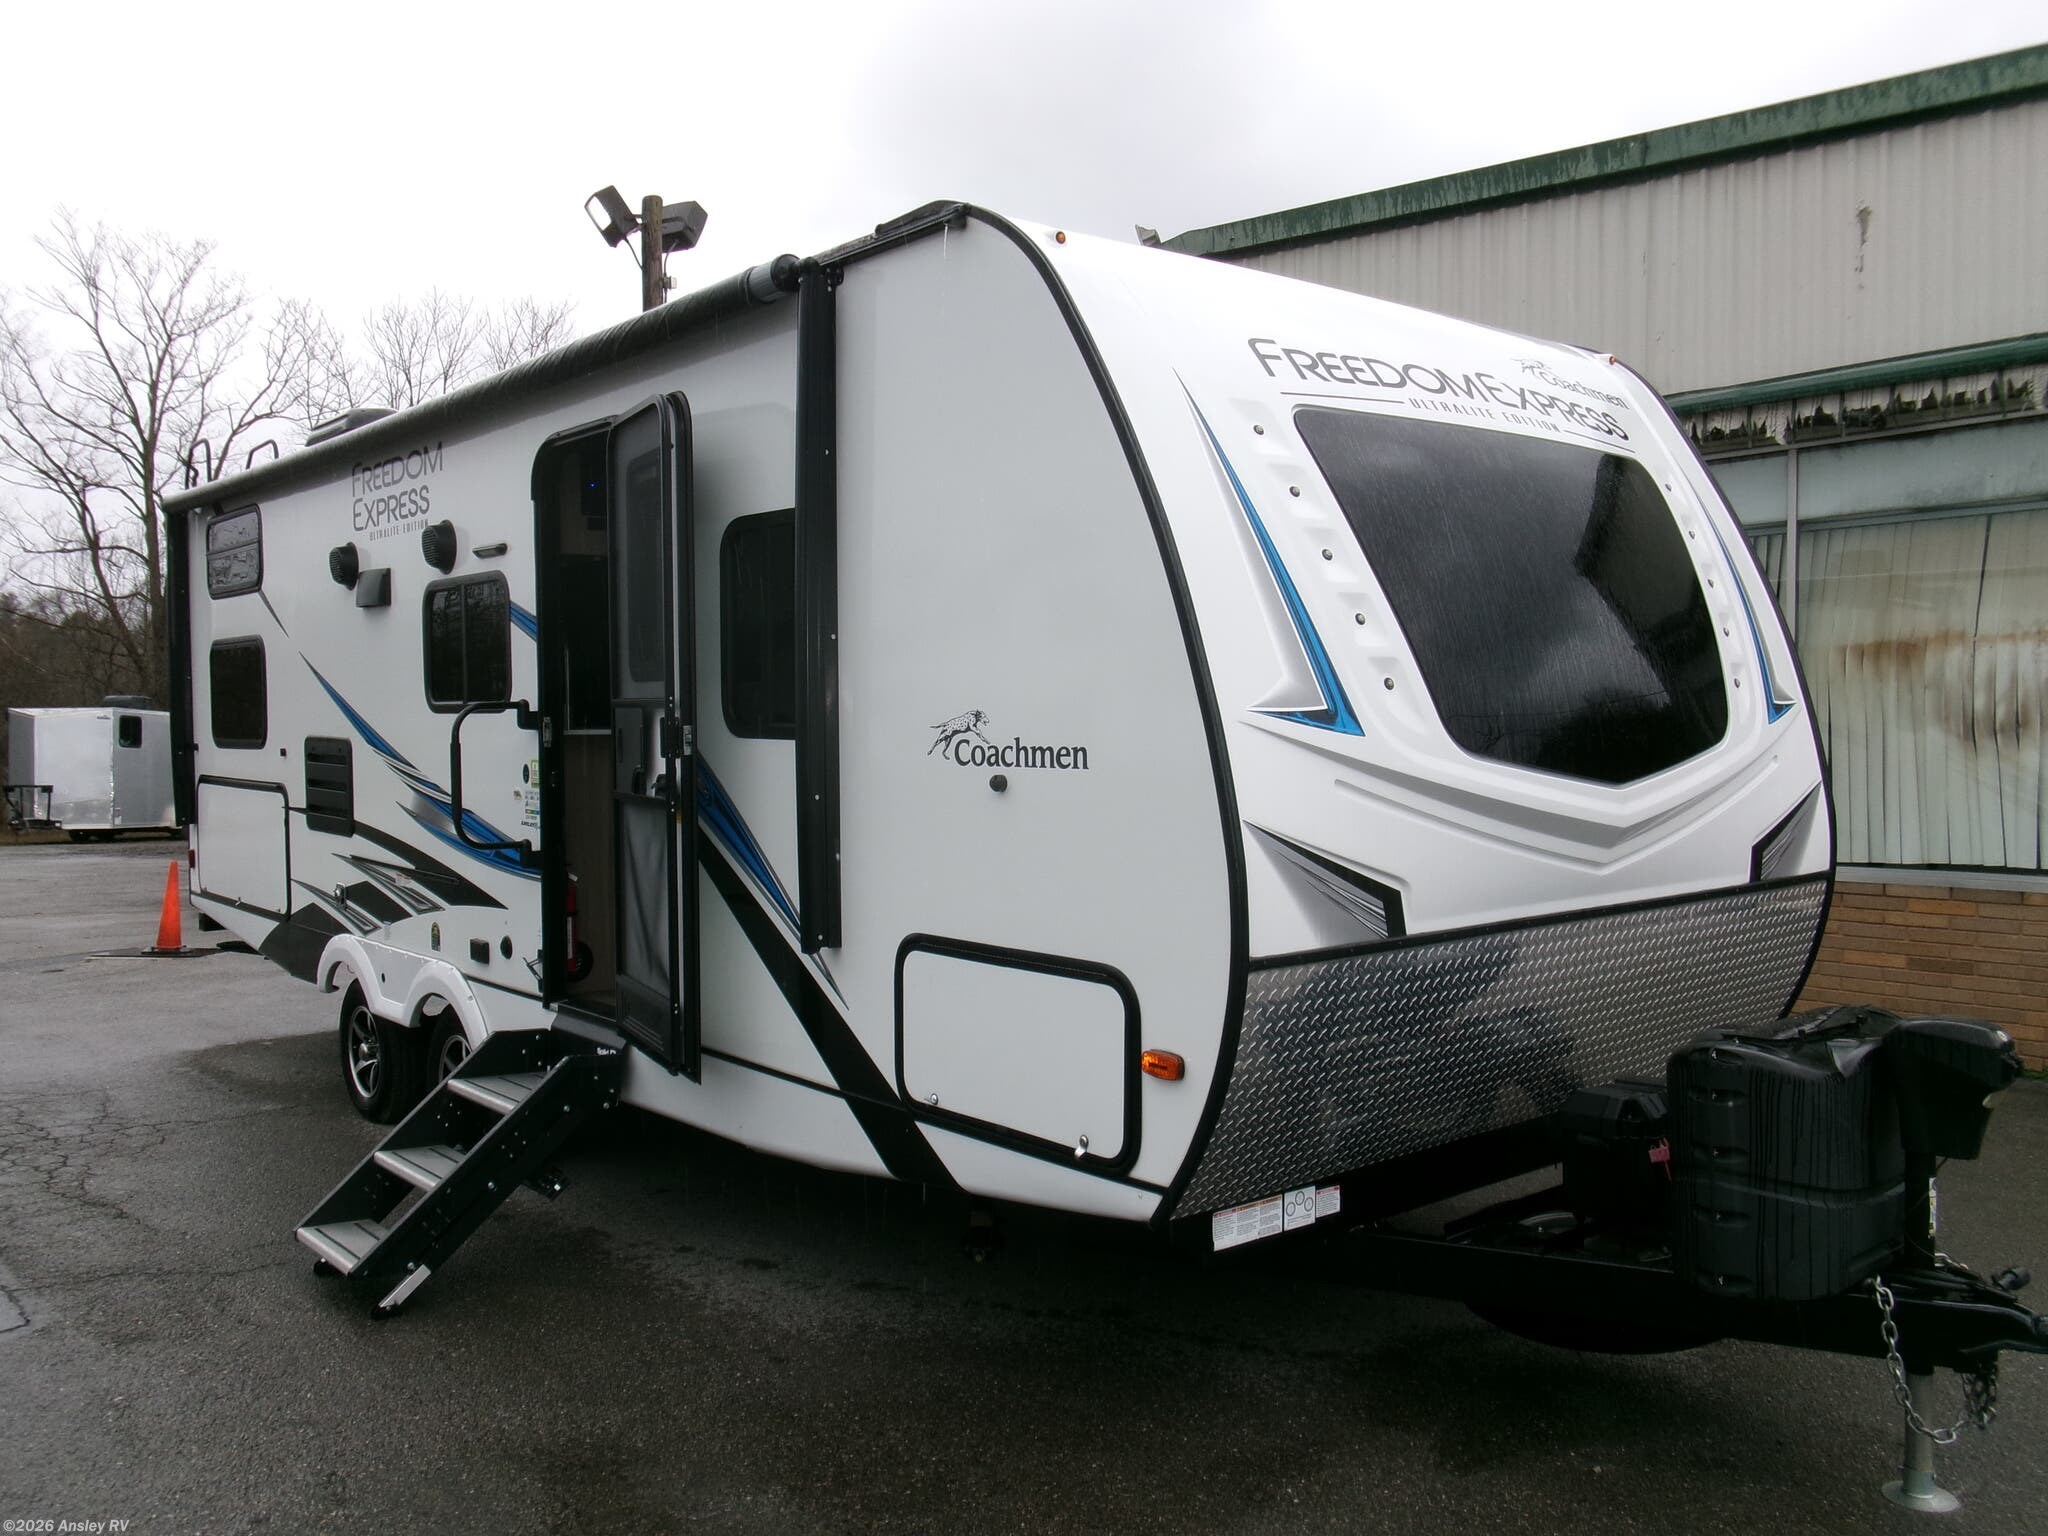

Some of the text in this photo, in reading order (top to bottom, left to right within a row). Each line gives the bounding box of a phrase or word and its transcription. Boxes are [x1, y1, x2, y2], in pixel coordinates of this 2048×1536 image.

[1539, 371, 1630, 410] Coachmen
[1408, 398, 1562, 433] ULTRALITE EDITION
[352, 441, 443, 497] FREEDOM
[353, 485, 430, 532] EXPRESS
[954, 737, 1089, 770] Coachmen
